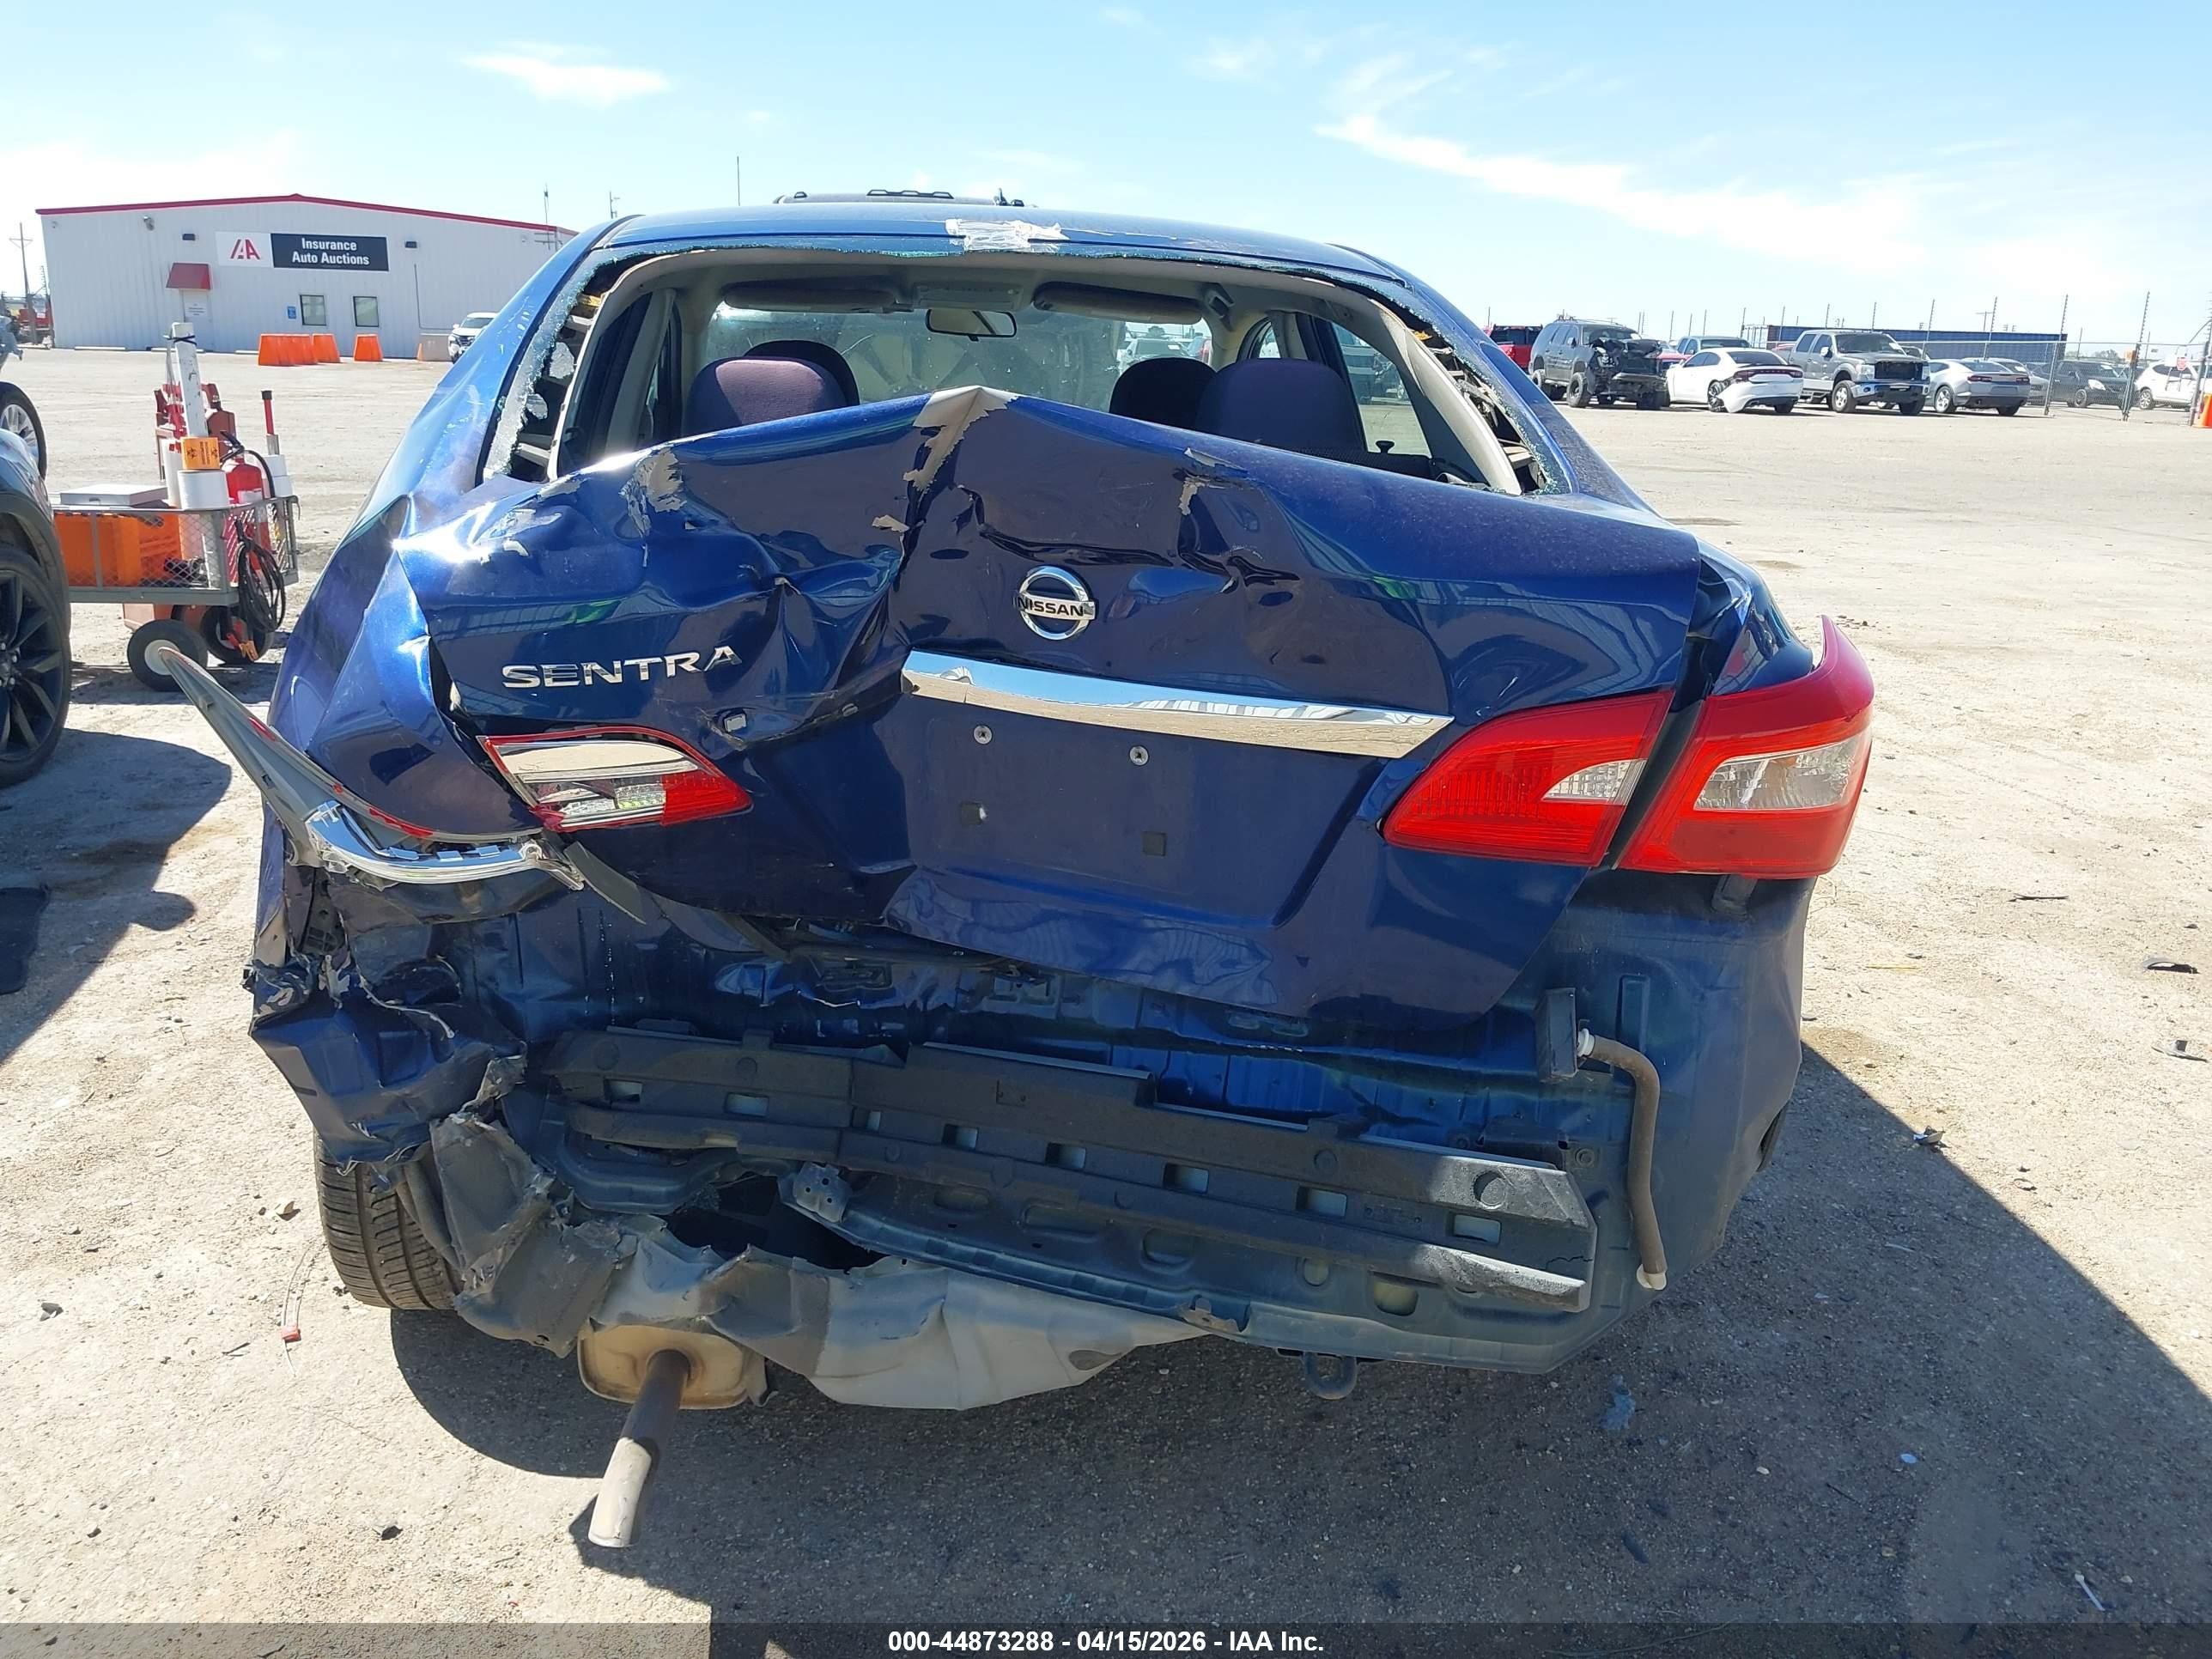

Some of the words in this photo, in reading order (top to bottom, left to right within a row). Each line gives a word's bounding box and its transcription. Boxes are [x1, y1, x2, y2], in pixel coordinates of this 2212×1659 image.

[301, 238, 357, 252] Insurance
[292, 252, 318, 264] Auto
[321, 252, 370, 265] Auctions
[1018, 596, 1084, 617] NISSAN
[502, 645, 743, 688] SENTRA
